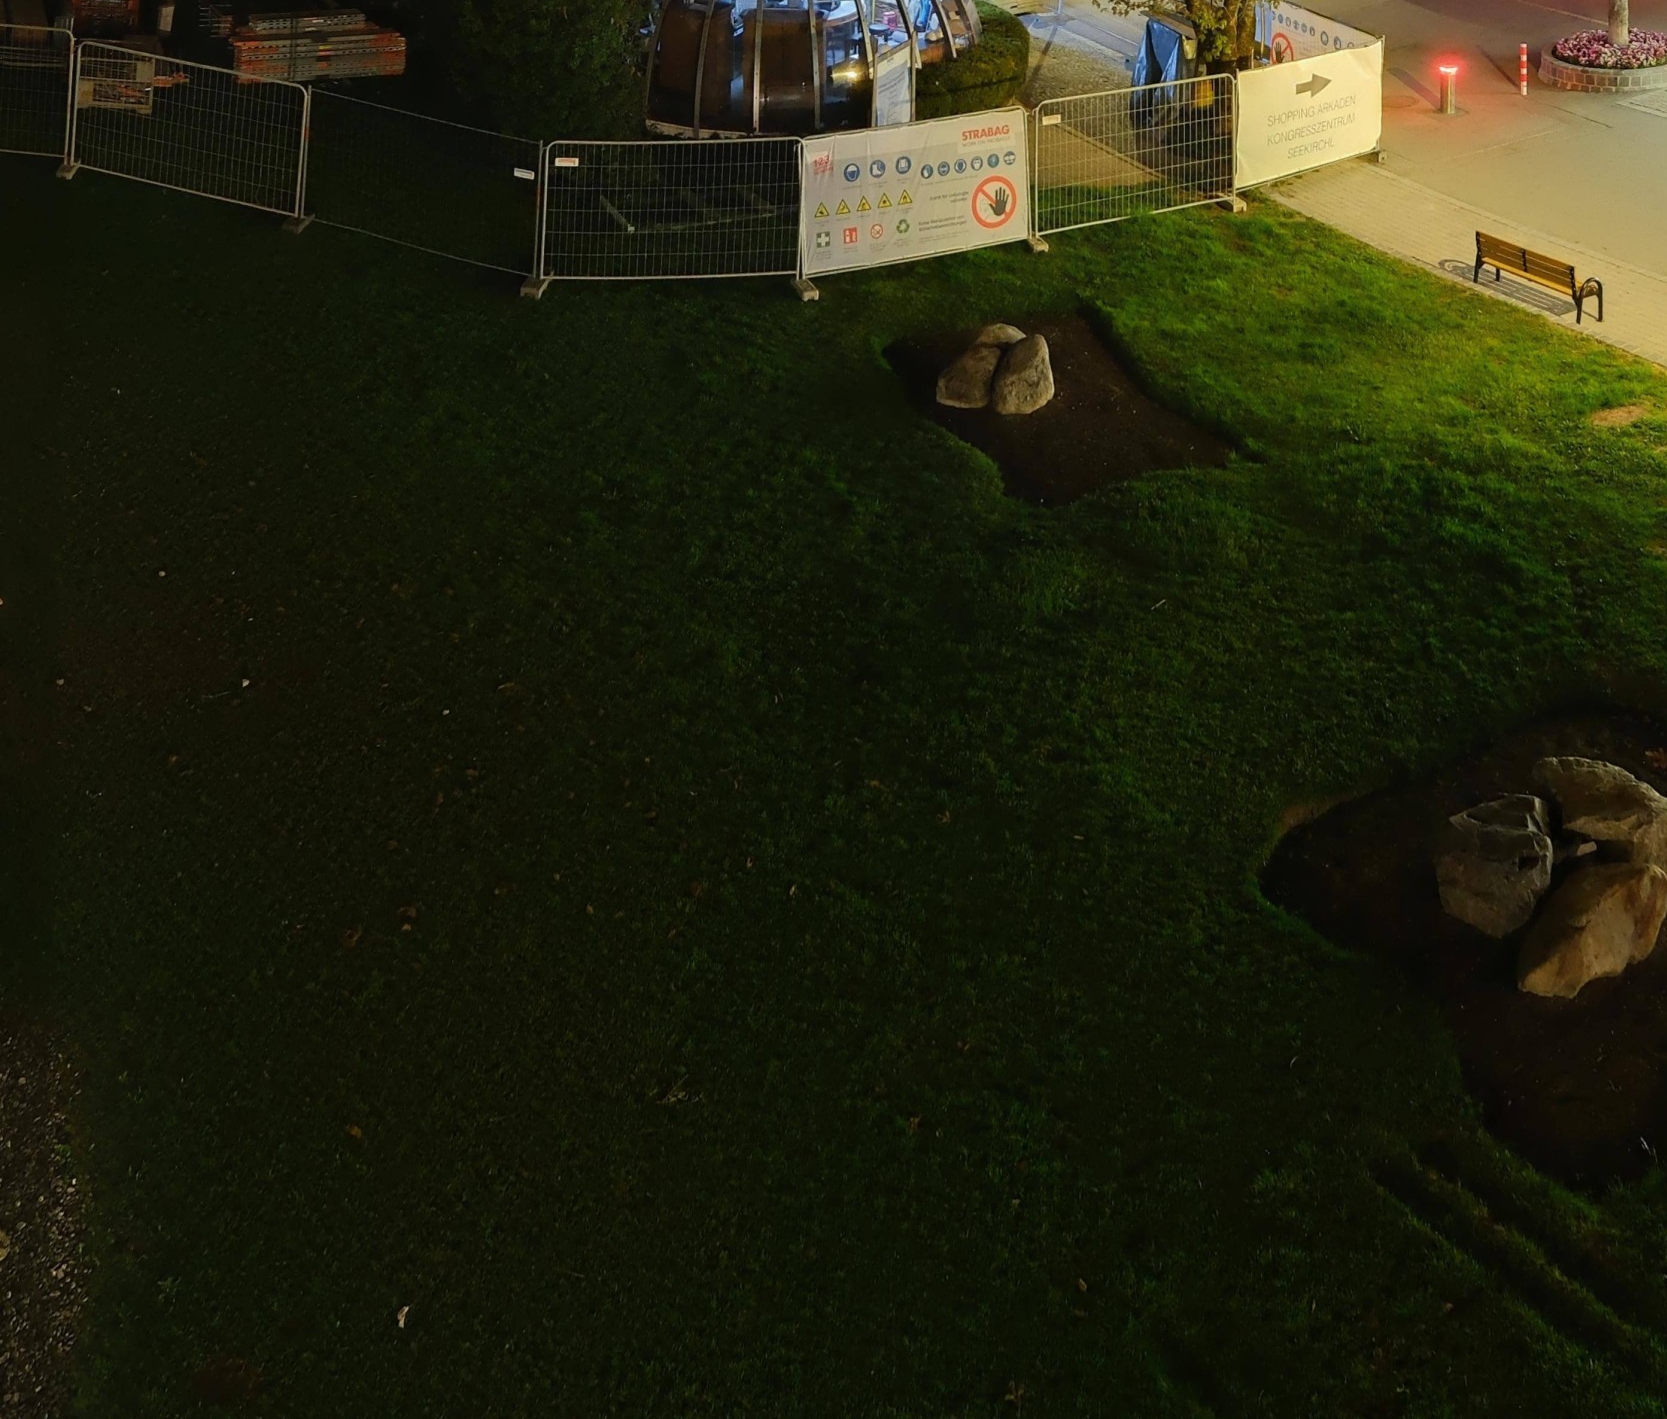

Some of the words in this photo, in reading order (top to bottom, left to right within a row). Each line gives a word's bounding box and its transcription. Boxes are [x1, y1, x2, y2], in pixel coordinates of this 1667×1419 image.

[1267, 106, 1315, 127] SHOPPING
[1318, 94, 1356, 114] ARKADEN
[961, 124, 1010, 141] STRABAG
[1267, 112, 1356, 146] KONGRESSZENTRUM
[1287, 137, 1335, 159] SEEKIRCHL
